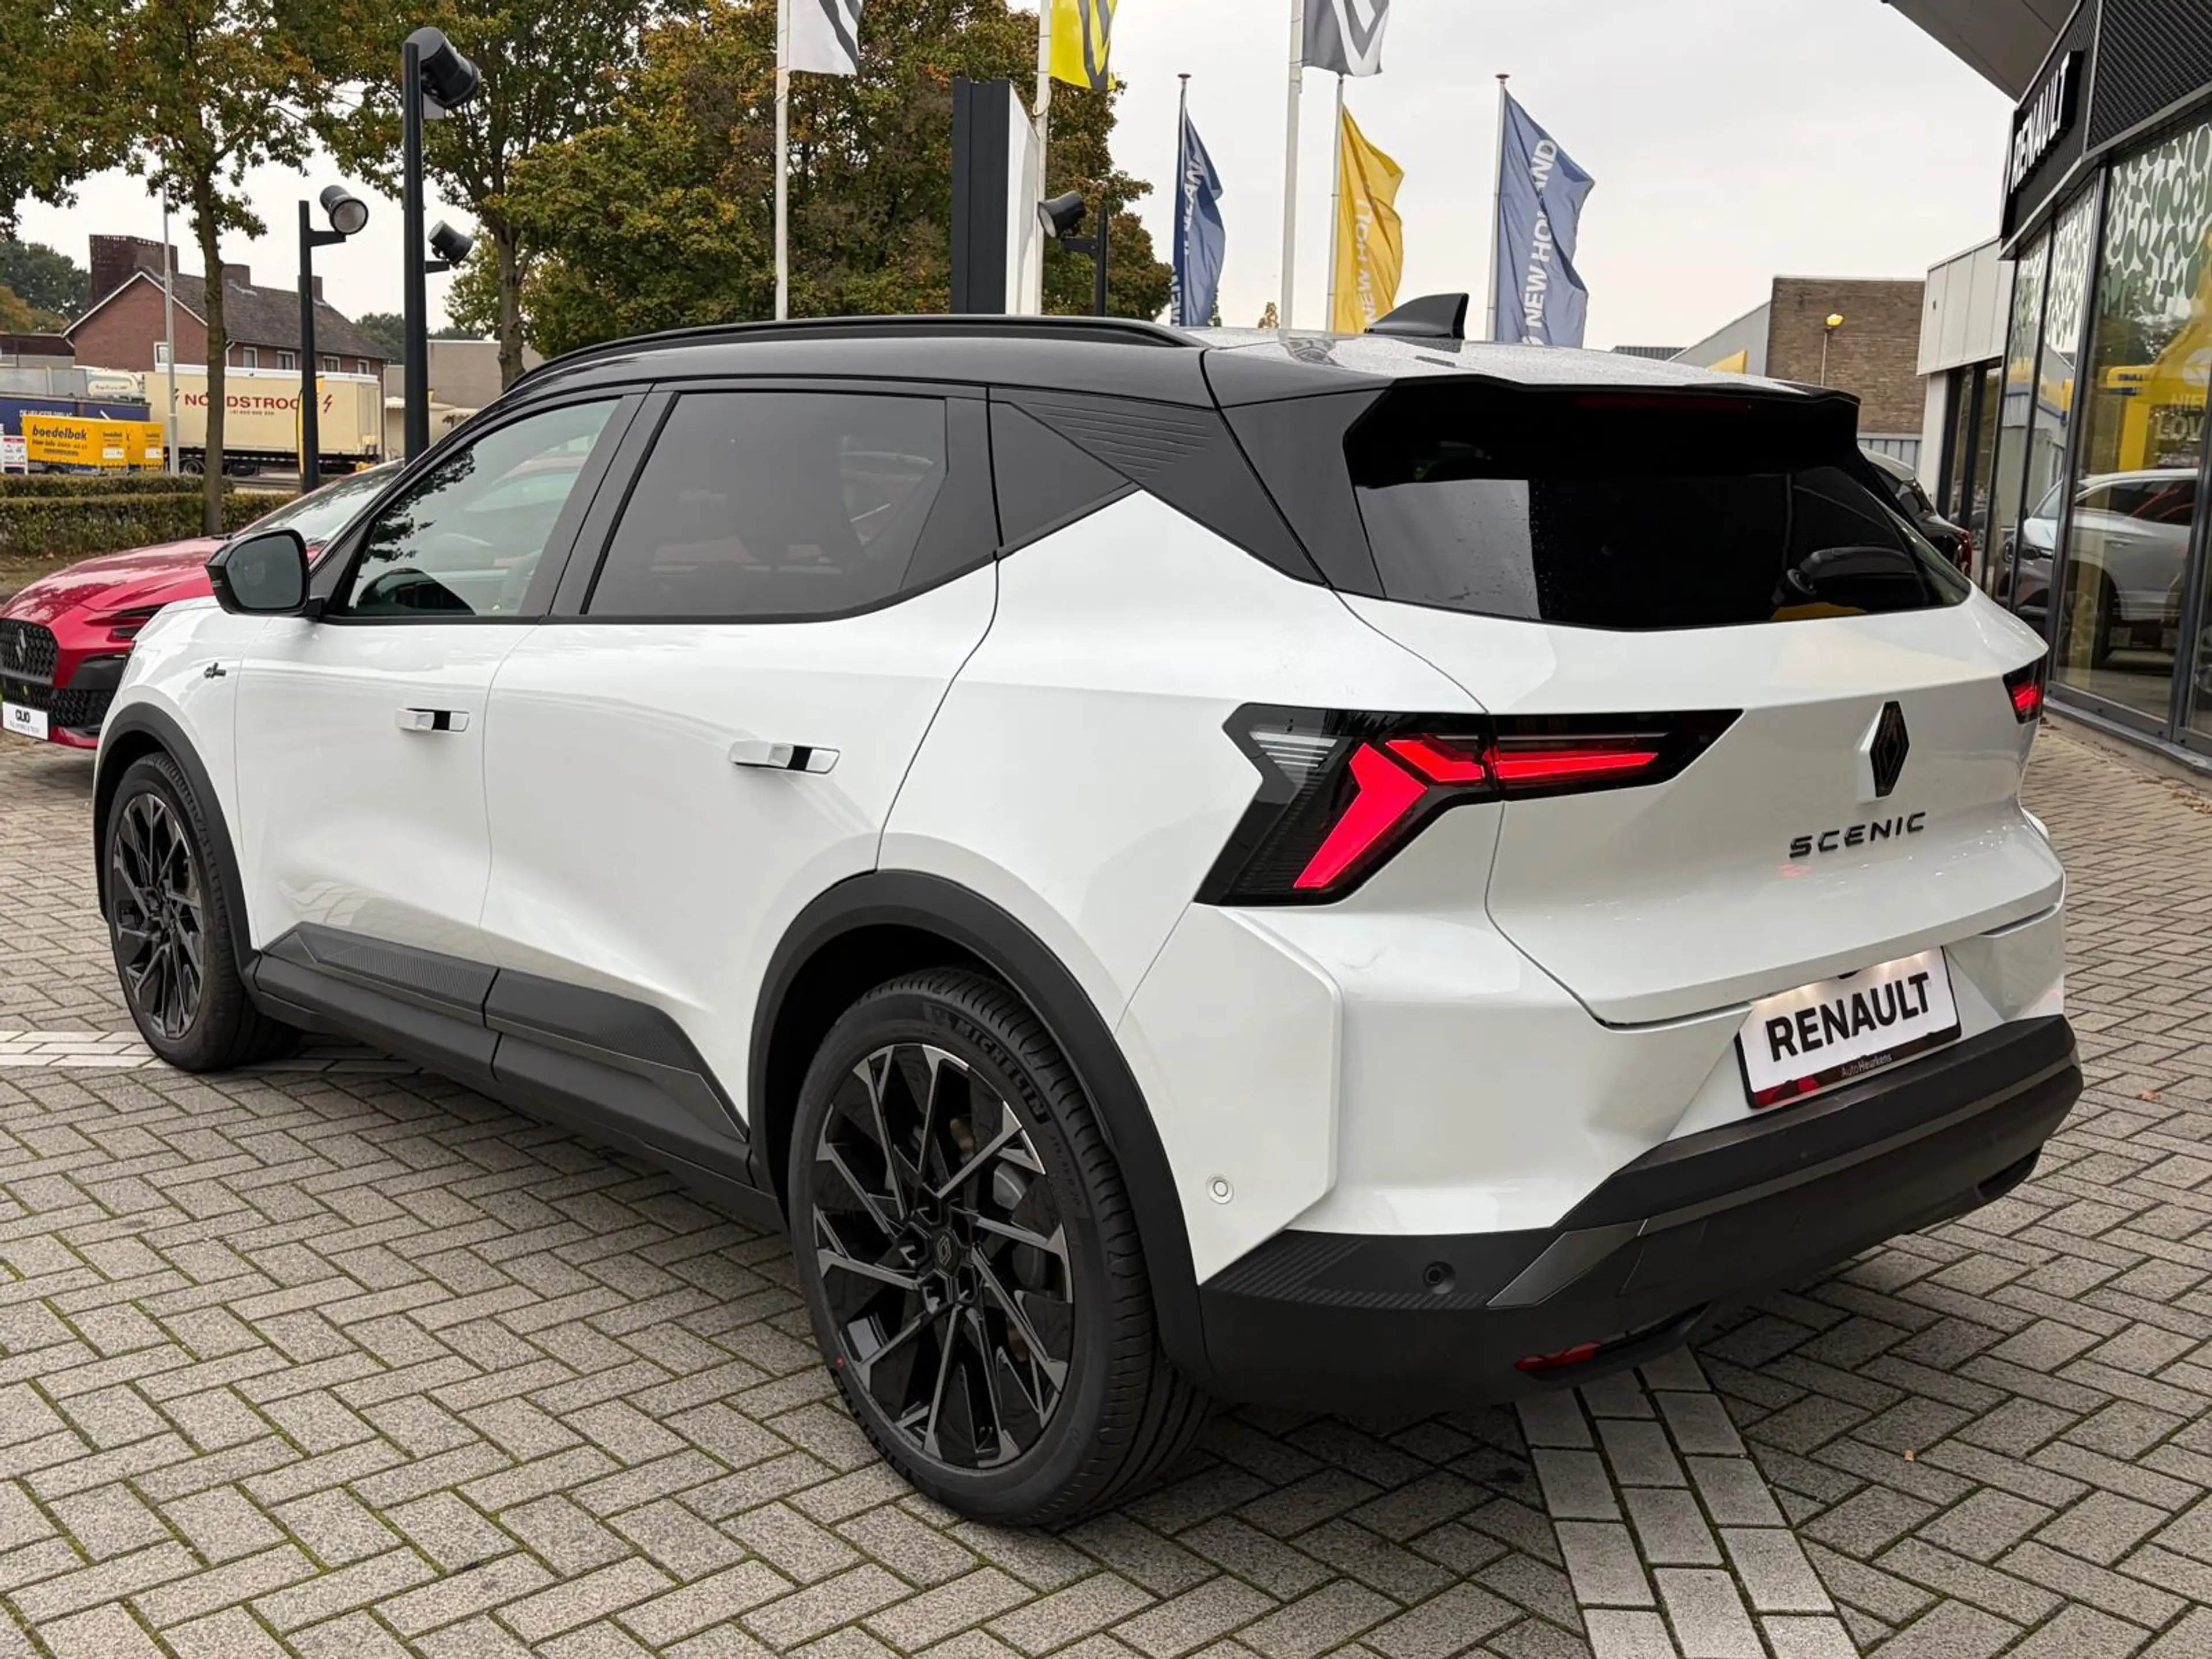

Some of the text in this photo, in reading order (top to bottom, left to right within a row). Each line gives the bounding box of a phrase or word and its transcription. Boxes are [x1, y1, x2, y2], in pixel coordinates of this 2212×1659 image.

[2010, 51, 2071, 194] RENAULT
[1358, 268, 1377, 326] NEW
[1525, 265, 1548, 328] NEW
[32, 424, 88, 440] boedelbak
[16, 709, 31, 724] CLIO
[1789, 812, 1926, 859] SCENIC
[1765, 972, 1930, 1062] RENAULT
[954, 1018, 1048, 1118] MICHELIN
